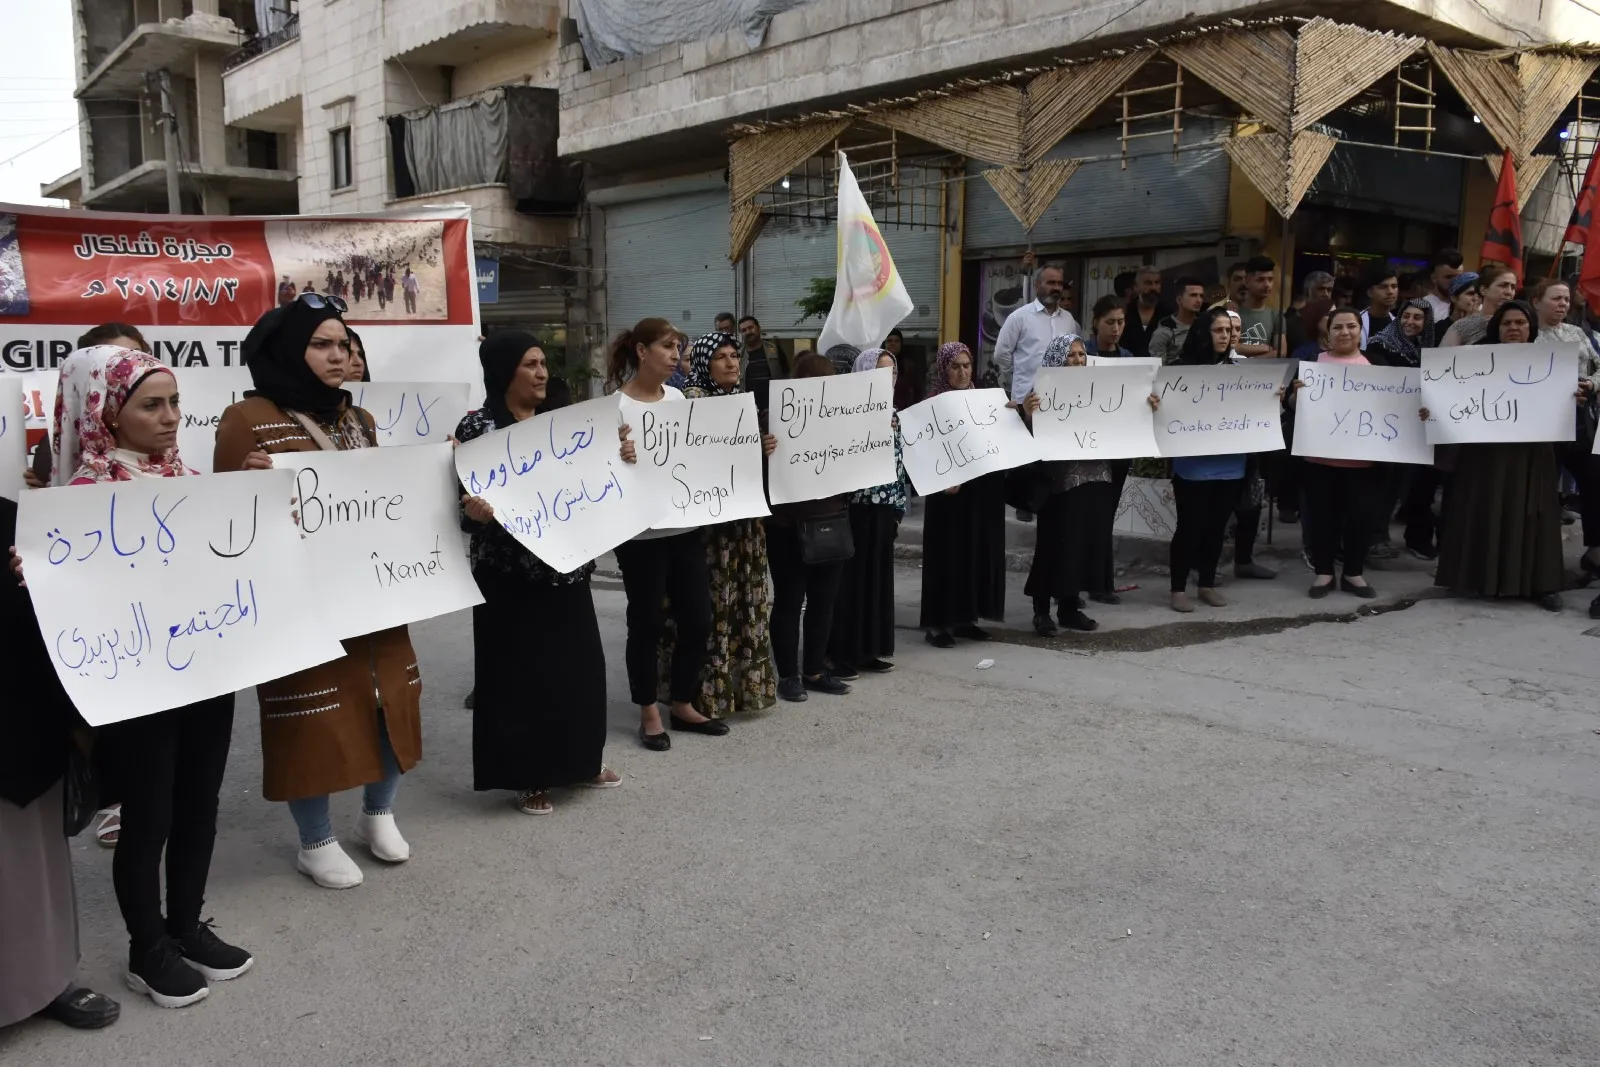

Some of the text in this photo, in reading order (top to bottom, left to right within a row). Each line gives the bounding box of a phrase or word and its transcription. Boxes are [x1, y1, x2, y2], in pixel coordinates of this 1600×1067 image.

[74, 231, 233, 262] مجزرة شنكال
[1161, 375, 1273, 404] Na ji qirkirina
[1303, 366, 1421, 402] Bijî berxwedan
[1508, 352, 1554, 385] لا
[780, 380, 888, 439] Bijî berxwedana
[1099, 383, 1125, 413] لا
[642, 400, 759, 467] Bijî berxwedana
[935, 431, 1000, 475] شنكال
[1167, 418, 1213, 435] Civaka
[1256, 421, 1271, 429] re
[464, 416, 594, 494] تحيا مقاومة
[297, 467, 403, 533] Bimire
[671, 463, 735, 517] Şengal
[49, 492, 257, 566] لا لإبادة
[371, 534, 444, 587] îxanet
[166, 579, 257, 671] المجتمع
